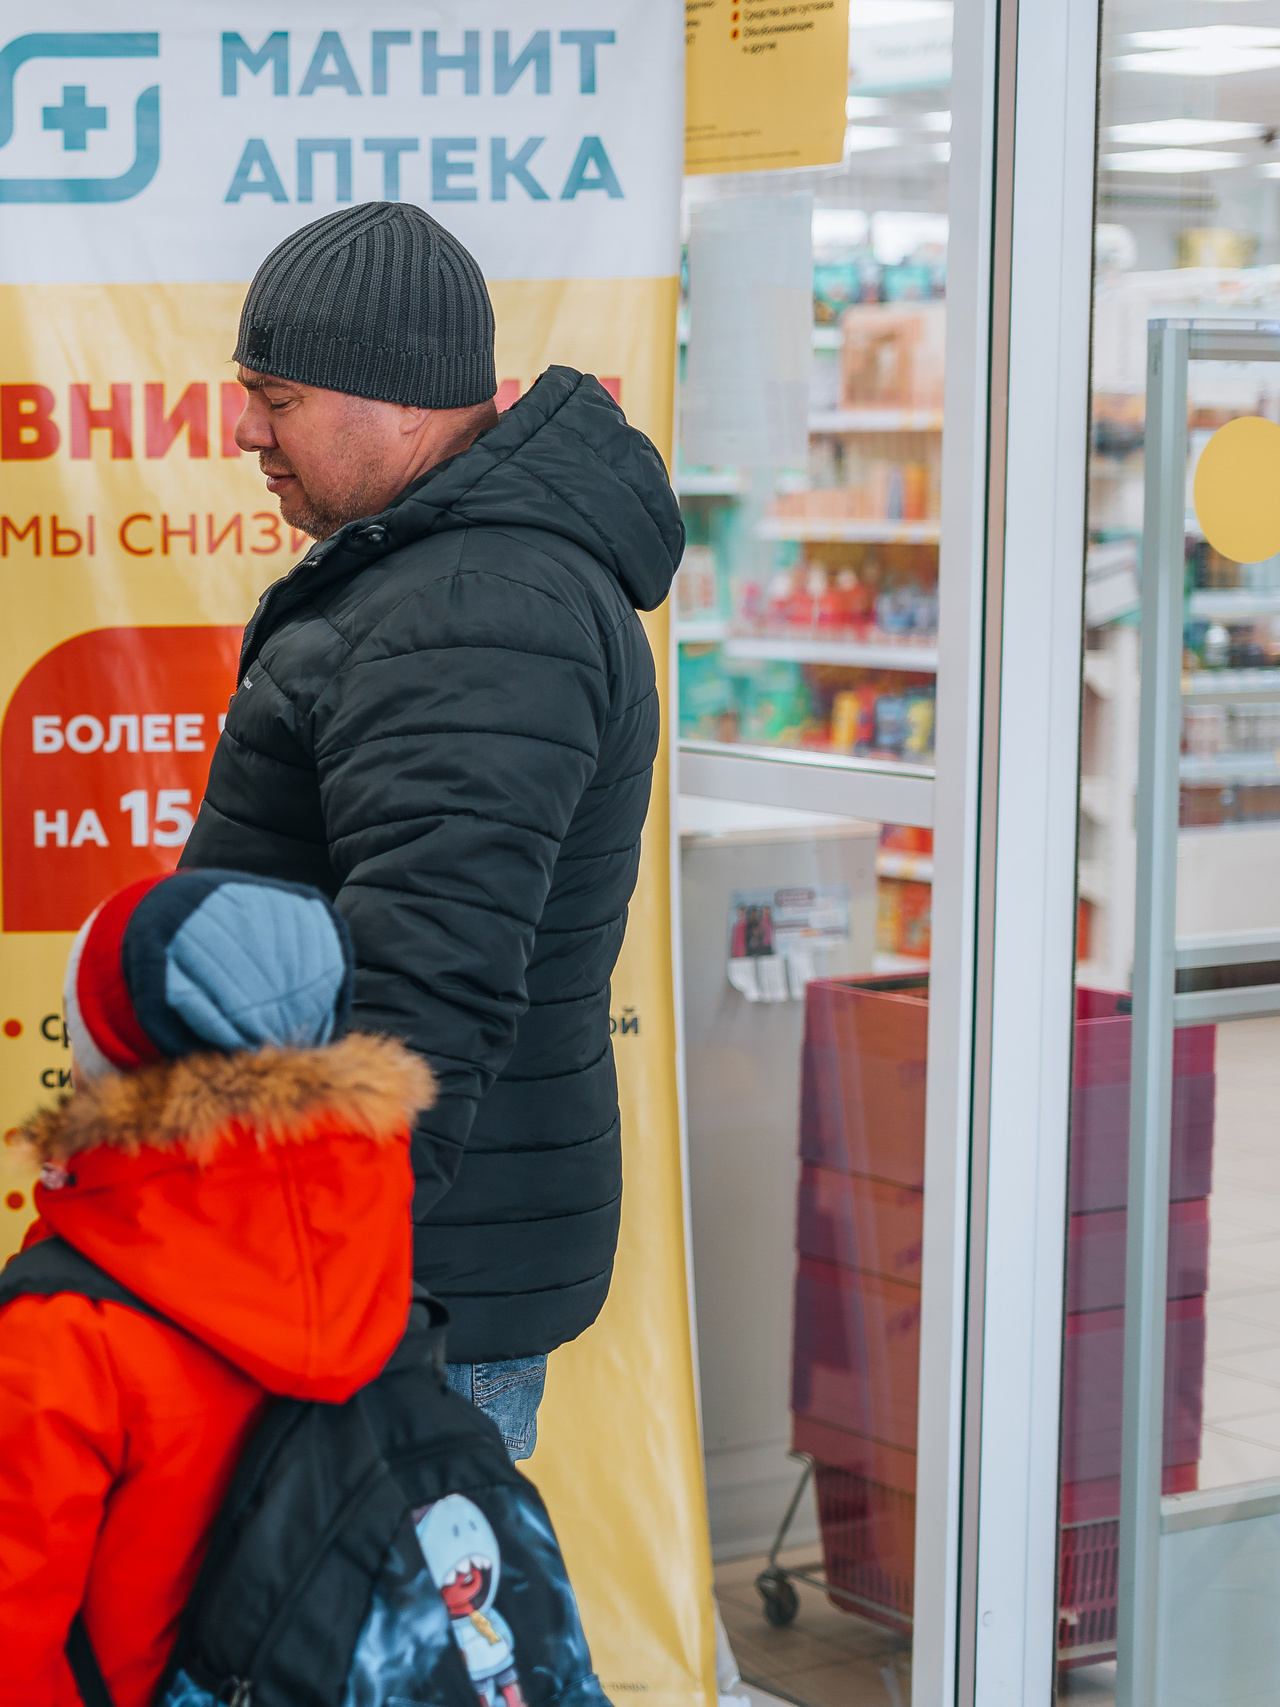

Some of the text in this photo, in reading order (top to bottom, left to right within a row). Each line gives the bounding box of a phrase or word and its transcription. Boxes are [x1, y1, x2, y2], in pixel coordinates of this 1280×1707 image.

[219, 29, 617, 97] МАГНИТ
[222, 135, 626, 205] АПТЕКА
[0, 513, 96, 558] МЫ
[33, 714, 206, 753] БОЛЕЕ
[35, 789, 196, 848] НА 15
